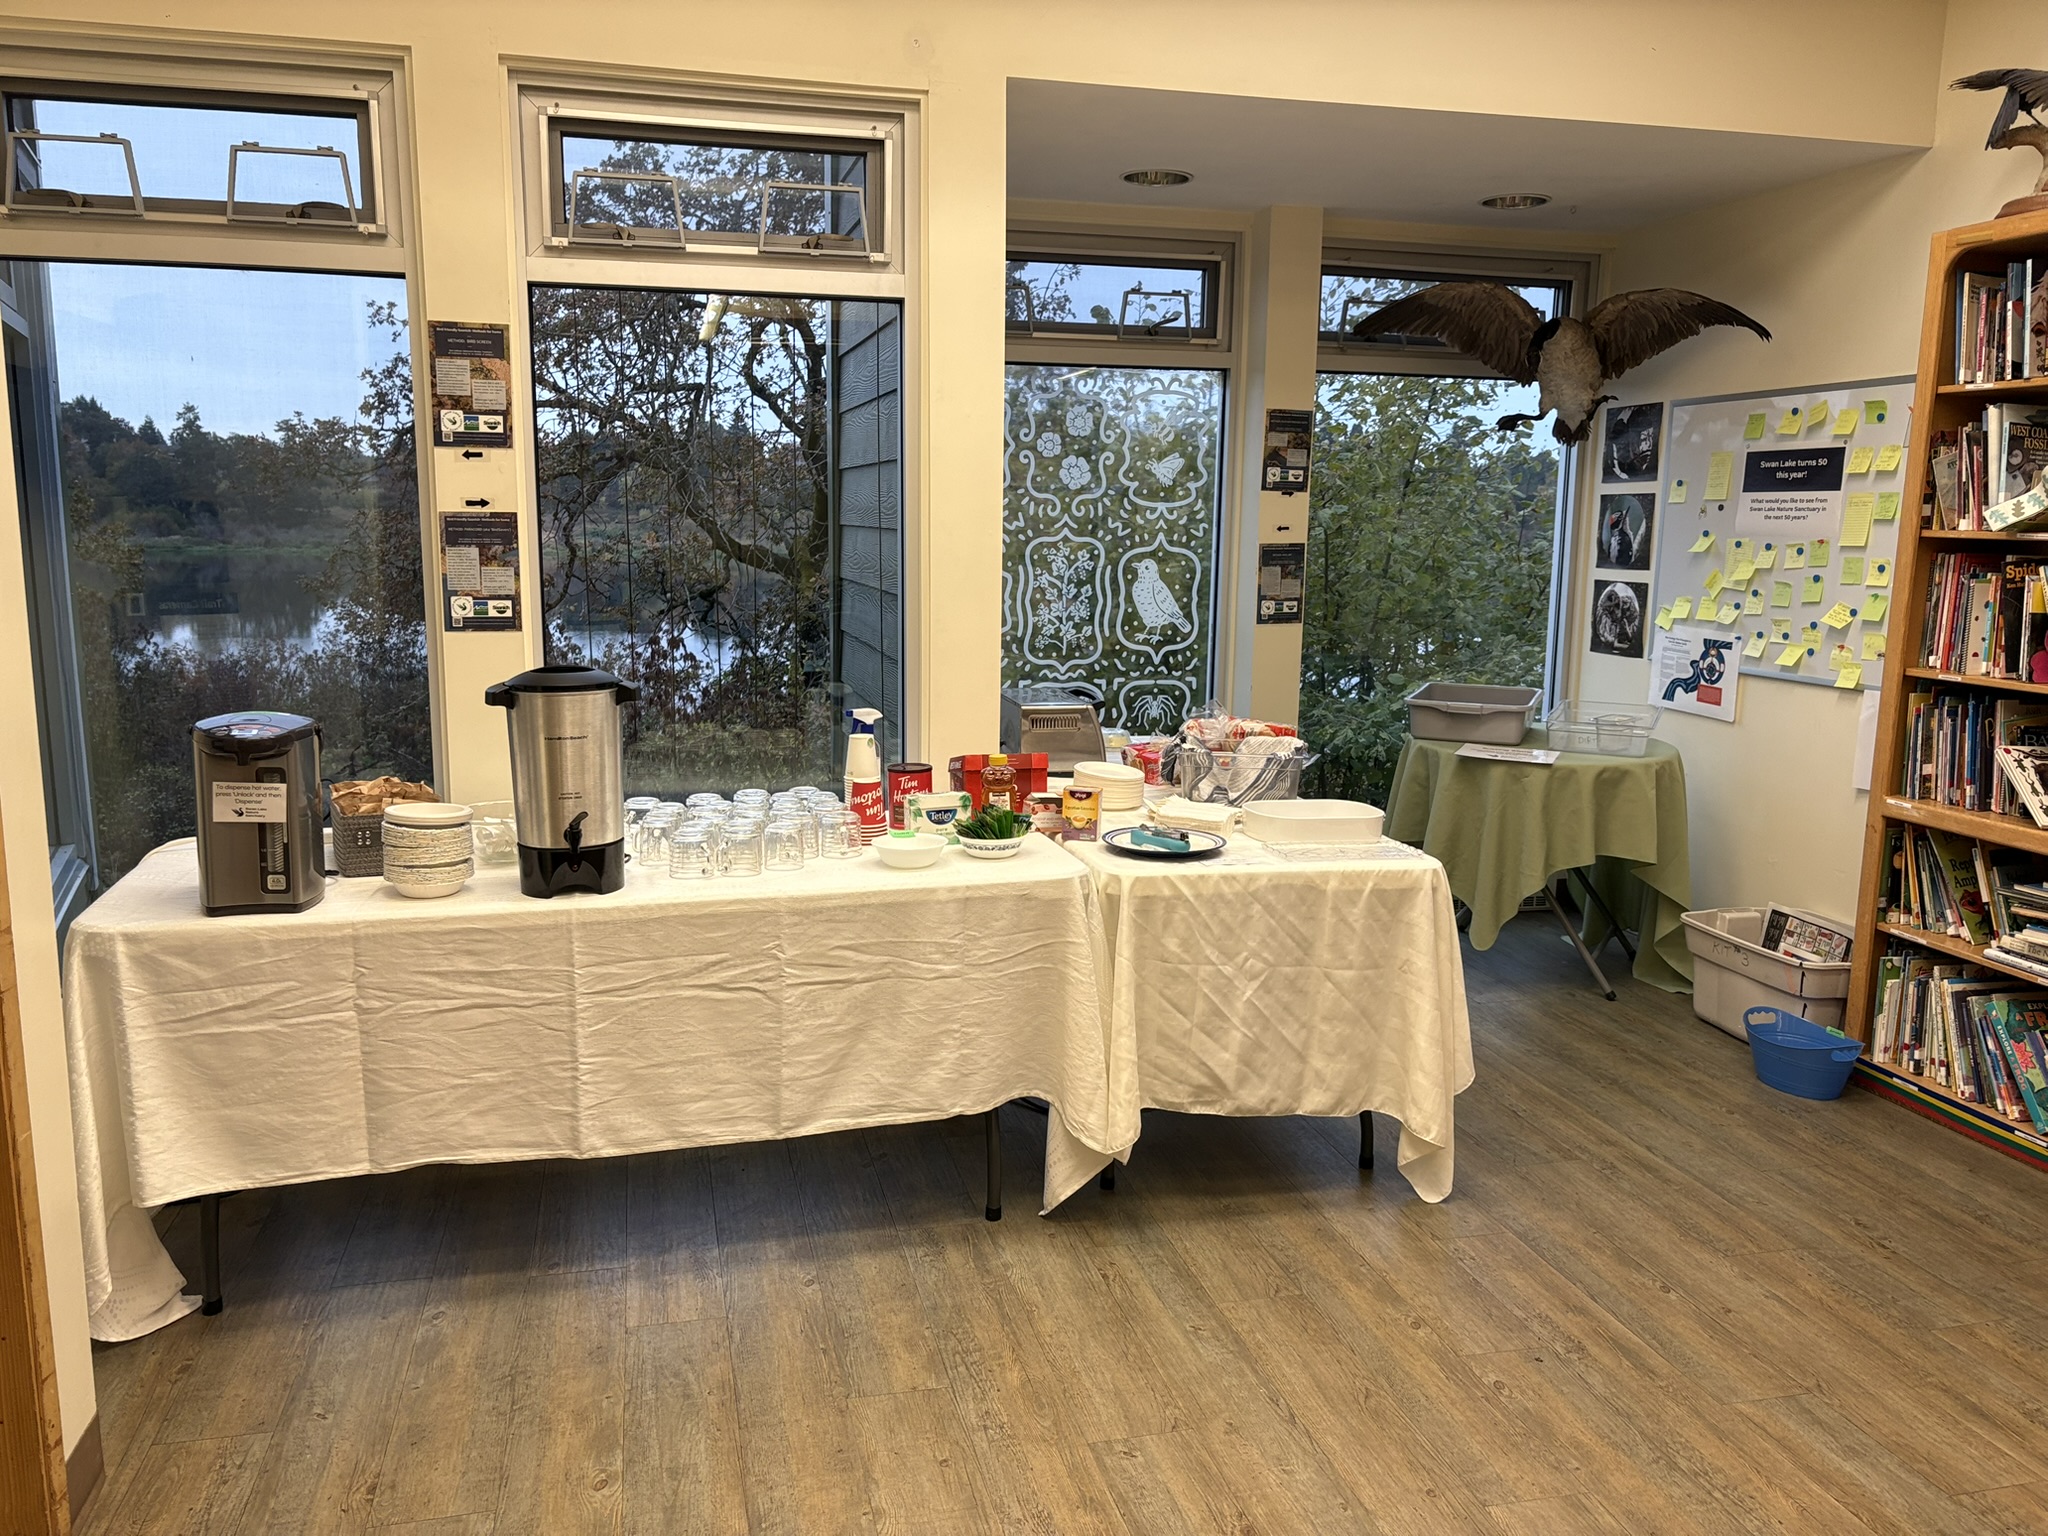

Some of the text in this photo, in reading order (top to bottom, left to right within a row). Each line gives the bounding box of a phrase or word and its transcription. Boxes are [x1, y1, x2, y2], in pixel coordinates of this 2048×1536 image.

[2010, 424, 2031, 437] WEST
[1760, 458, 1828, 469] Swan Lake turns 50
[1776, 470, 1808, 481] this year!
[2025, 734, 2048, 746] BA
[898, 776, 918, 790] Tim
[850, 785, 884, 806] orton
[866, 802, 887, 821] Tim
[929, 809, 953, 821] Tetley
[1713, 941, 1732, 957] KIT
[1996, 1025, 2013, 1055] EXPLORE
[2012, 1062, 2028, 1091] FROG
